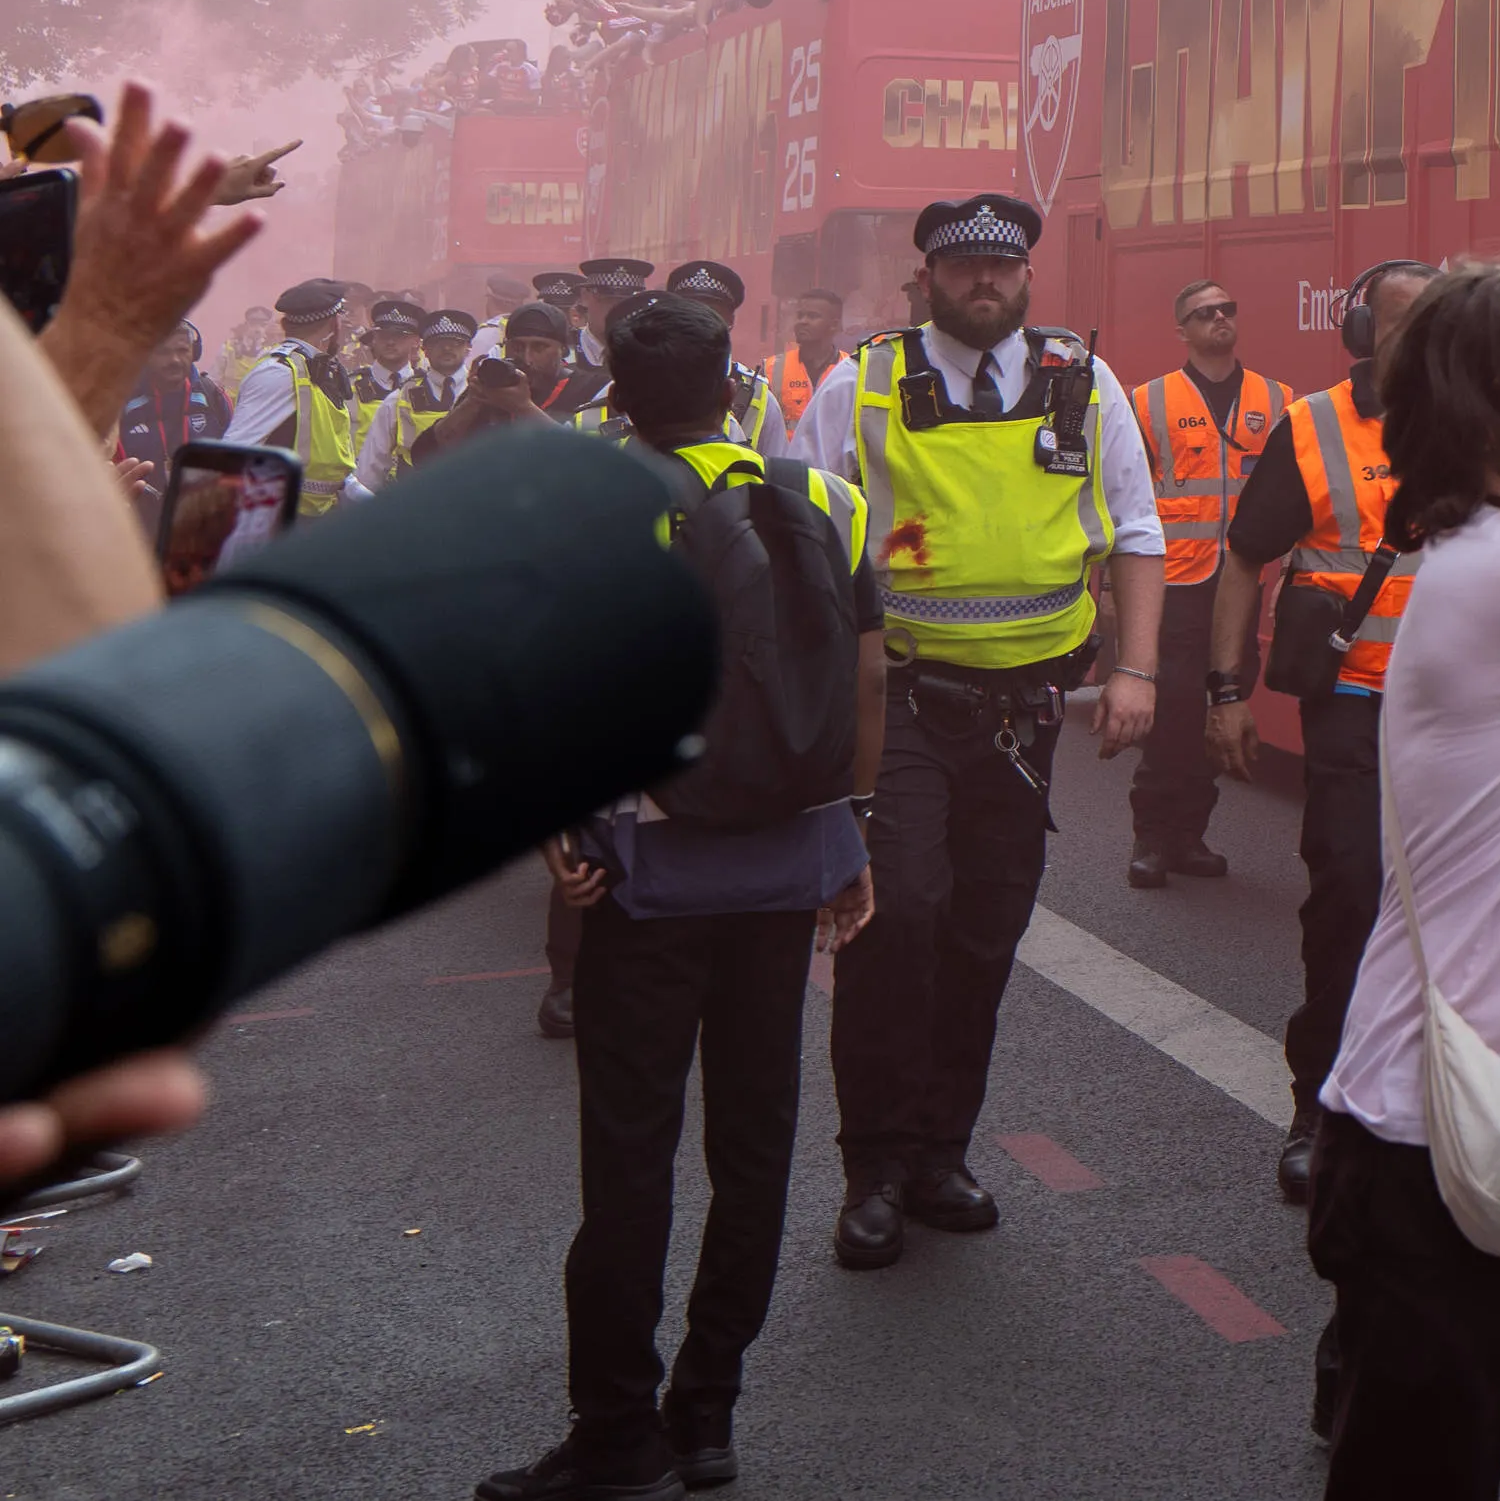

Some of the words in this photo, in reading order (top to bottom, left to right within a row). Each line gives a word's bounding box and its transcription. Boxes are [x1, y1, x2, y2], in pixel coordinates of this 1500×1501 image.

[788, 39, 822, 118] 25
[782, 135, 819, 214] 26
[1178, 416, 1207, 429] 064
